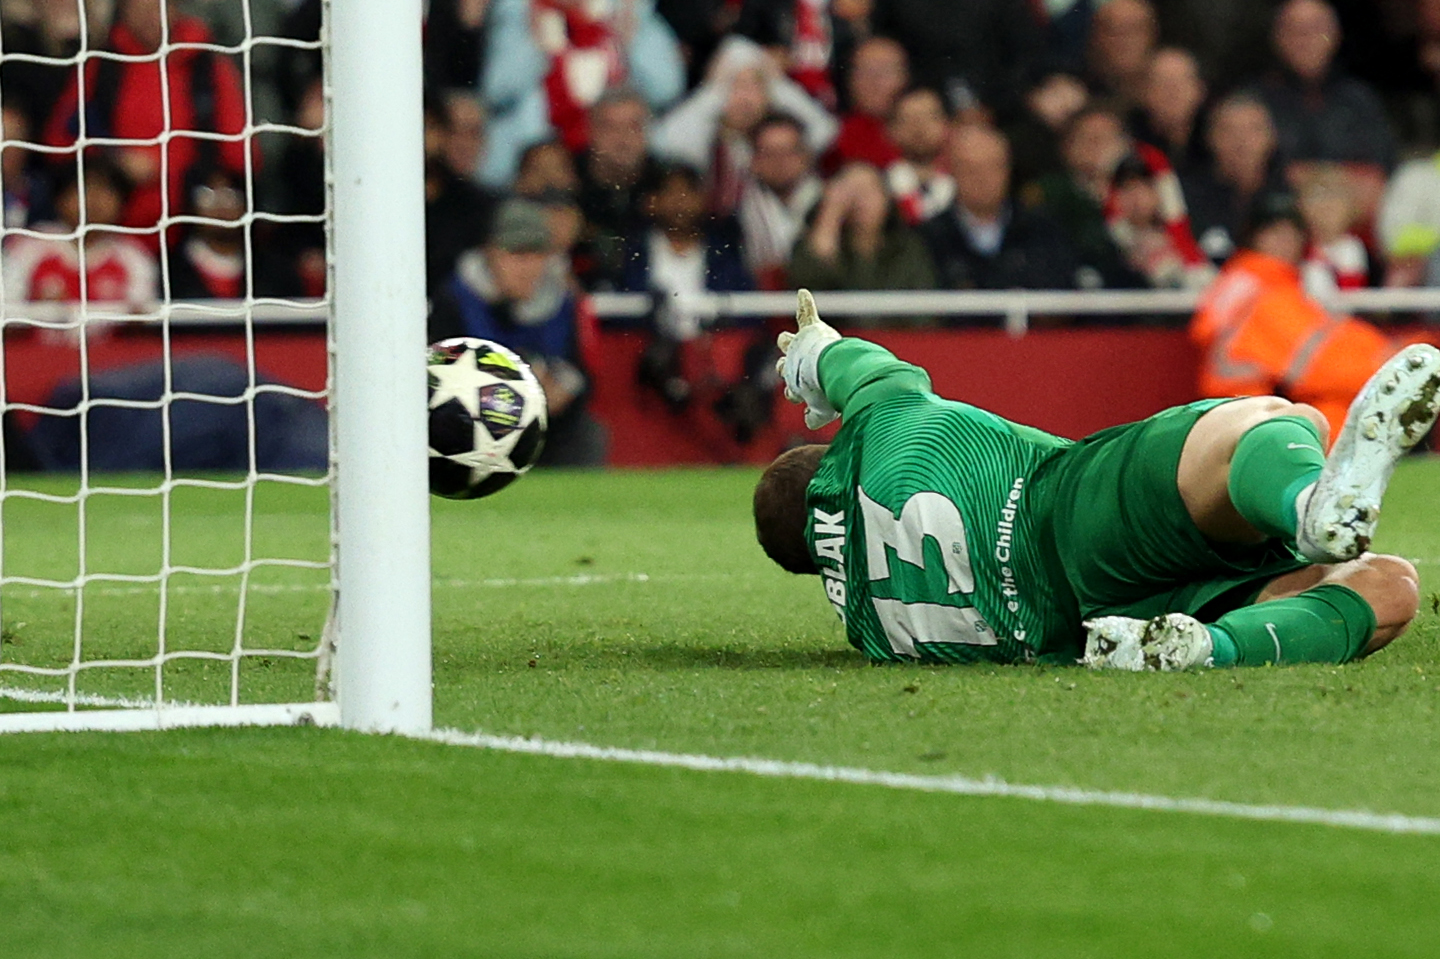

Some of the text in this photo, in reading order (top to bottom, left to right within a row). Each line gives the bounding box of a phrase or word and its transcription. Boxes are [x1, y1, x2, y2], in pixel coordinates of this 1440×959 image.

[813, 507, 847, 626] BLAK
[857, 484, 999, 659] 13
[995, 476, 1025, 564] Children
[1001, 566, 1020, 598] the
